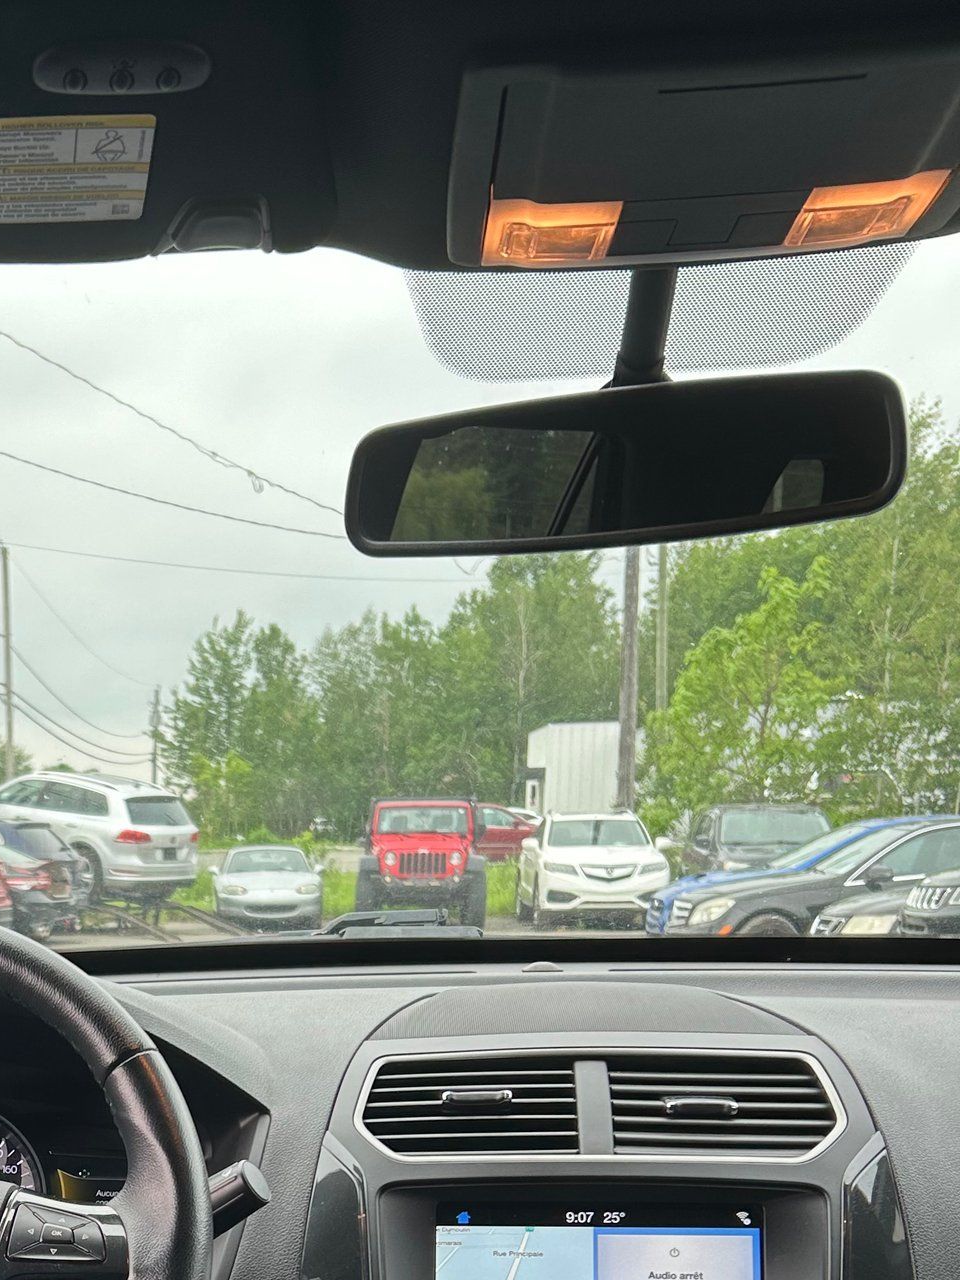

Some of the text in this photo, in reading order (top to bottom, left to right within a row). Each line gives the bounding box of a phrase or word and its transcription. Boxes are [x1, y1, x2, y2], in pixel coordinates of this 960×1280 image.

[565, 1211, 626, 1224] 9:07 25°
[51, 1229, 63, 1237] OK
[508, 1250, 544, 1258] Principale
[648, 1271, 704, 1280] Audio arrêt
